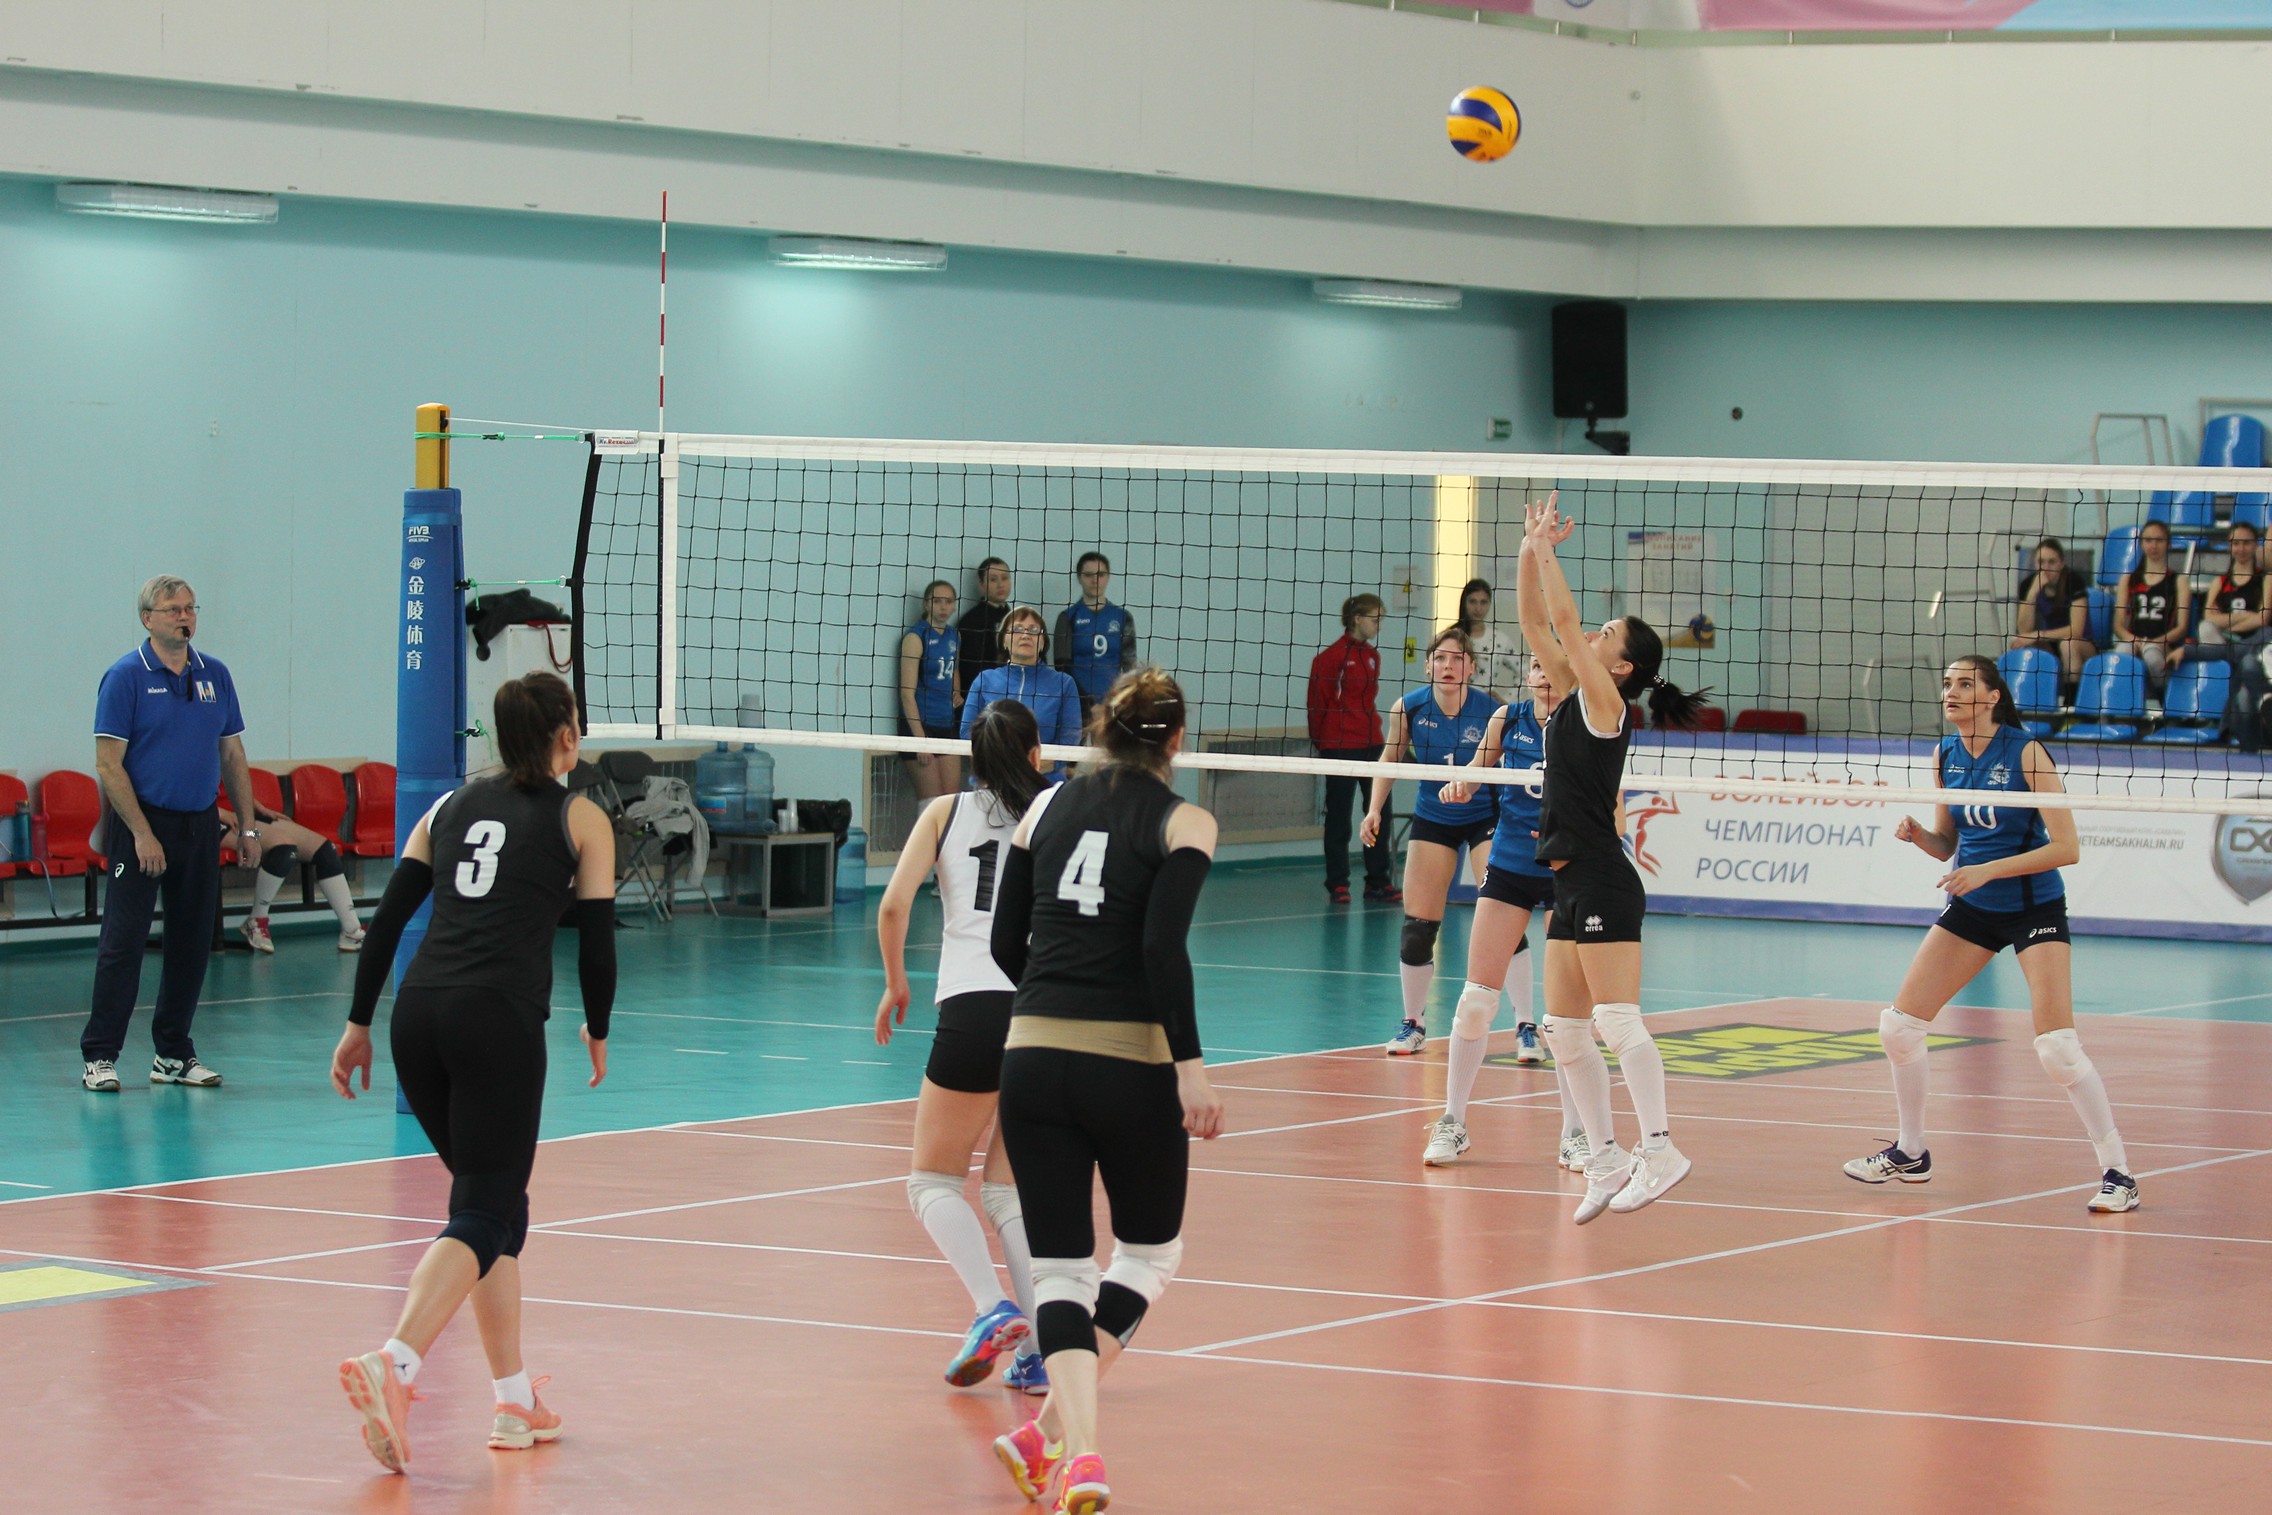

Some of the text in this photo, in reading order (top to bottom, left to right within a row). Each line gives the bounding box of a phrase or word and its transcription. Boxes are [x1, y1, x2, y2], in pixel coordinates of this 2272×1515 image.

[408, 525, 430, 535] FIVB
[2138, 594, 2166, 619] 12
[406, 575, 425, 670] 金陵体育
[1093, 634, 1108, 657] 9
[937, 655, 955, 680] 14
[1704, 818, 1882, 848] ЧЕМПИОНАТ
[454, 819, 507, 898] 3
[1696, 857, 1810, 884] РОССИИ
[1056, 829, 1110, 917] 4
